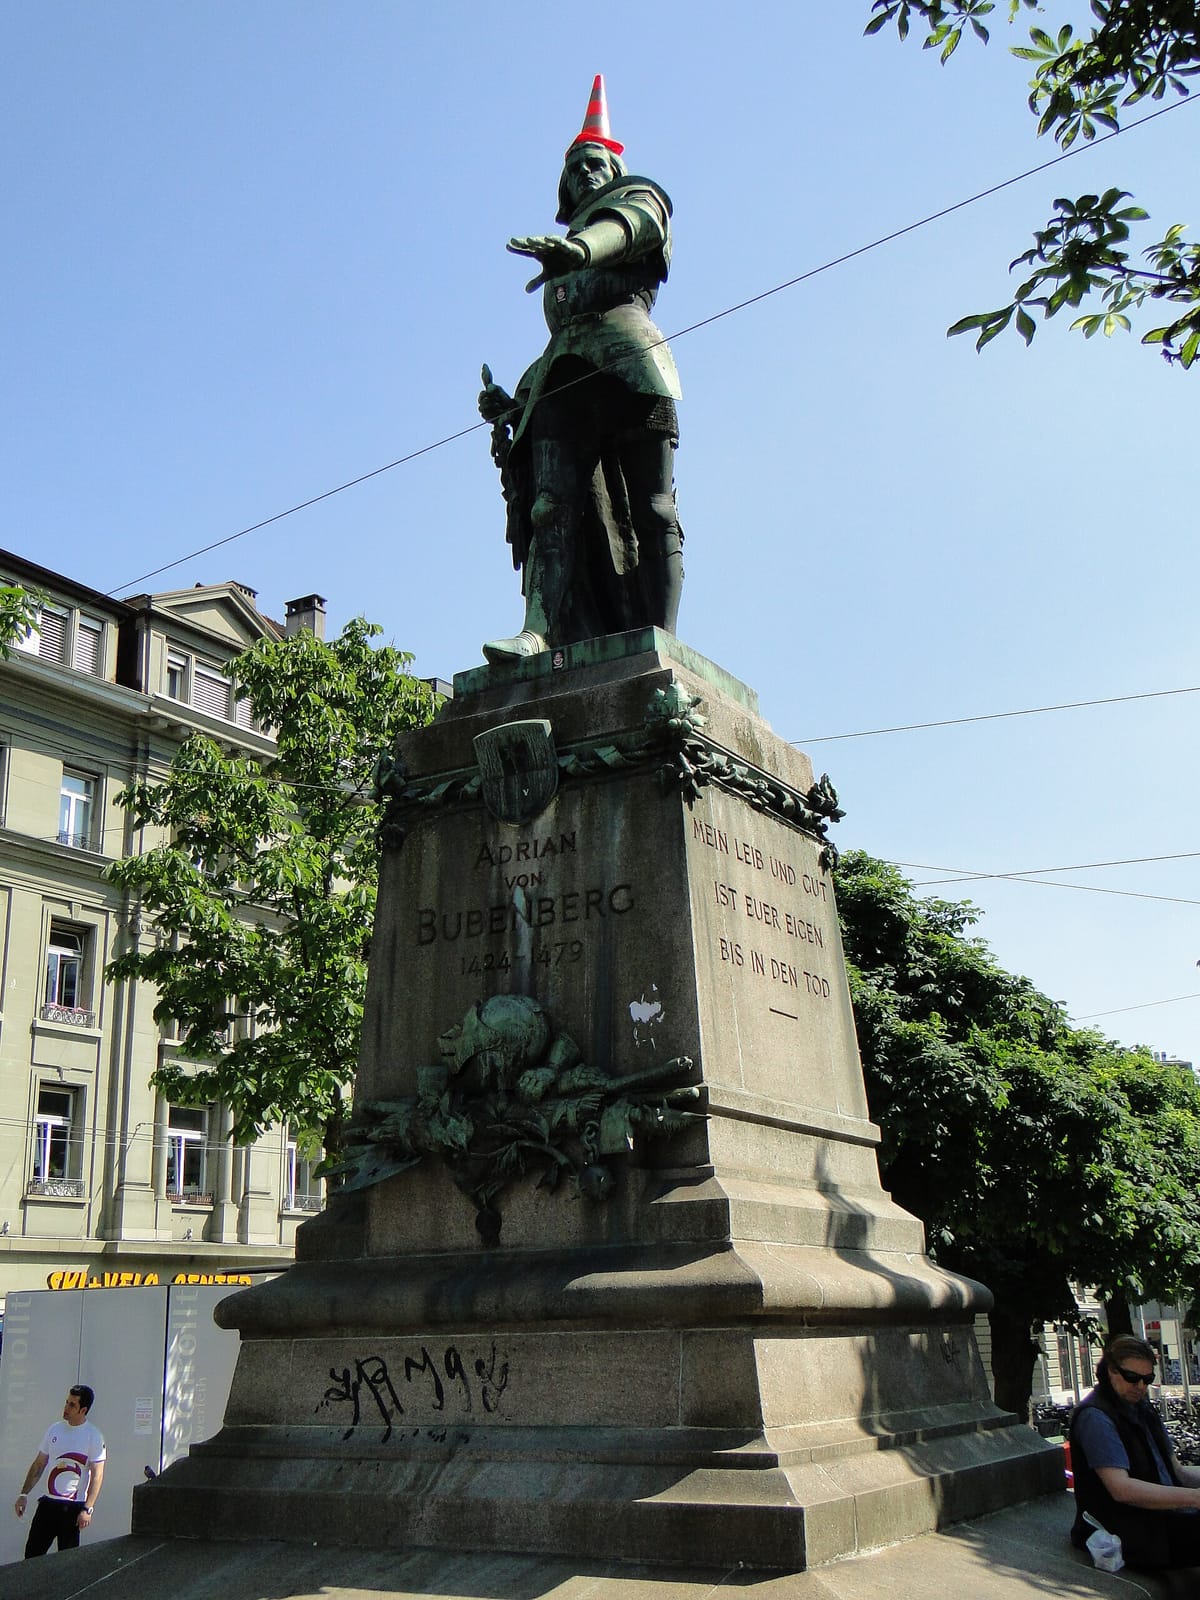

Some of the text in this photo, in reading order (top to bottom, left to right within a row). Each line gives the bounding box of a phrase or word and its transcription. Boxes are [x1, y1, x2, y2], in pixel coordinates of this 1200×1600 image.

[474, 831, 577, 869] ADRIAN
[505, 871, 543, 890] VON
[693, 817, 827, 902] MEIN LEIB UND GUT
[416, 884, 635, 946] BUBENBERG
[714, 881, 824, 949] IST EUER EIGEN
[719, 937, 830, 998] BIS IN DEN TOD
